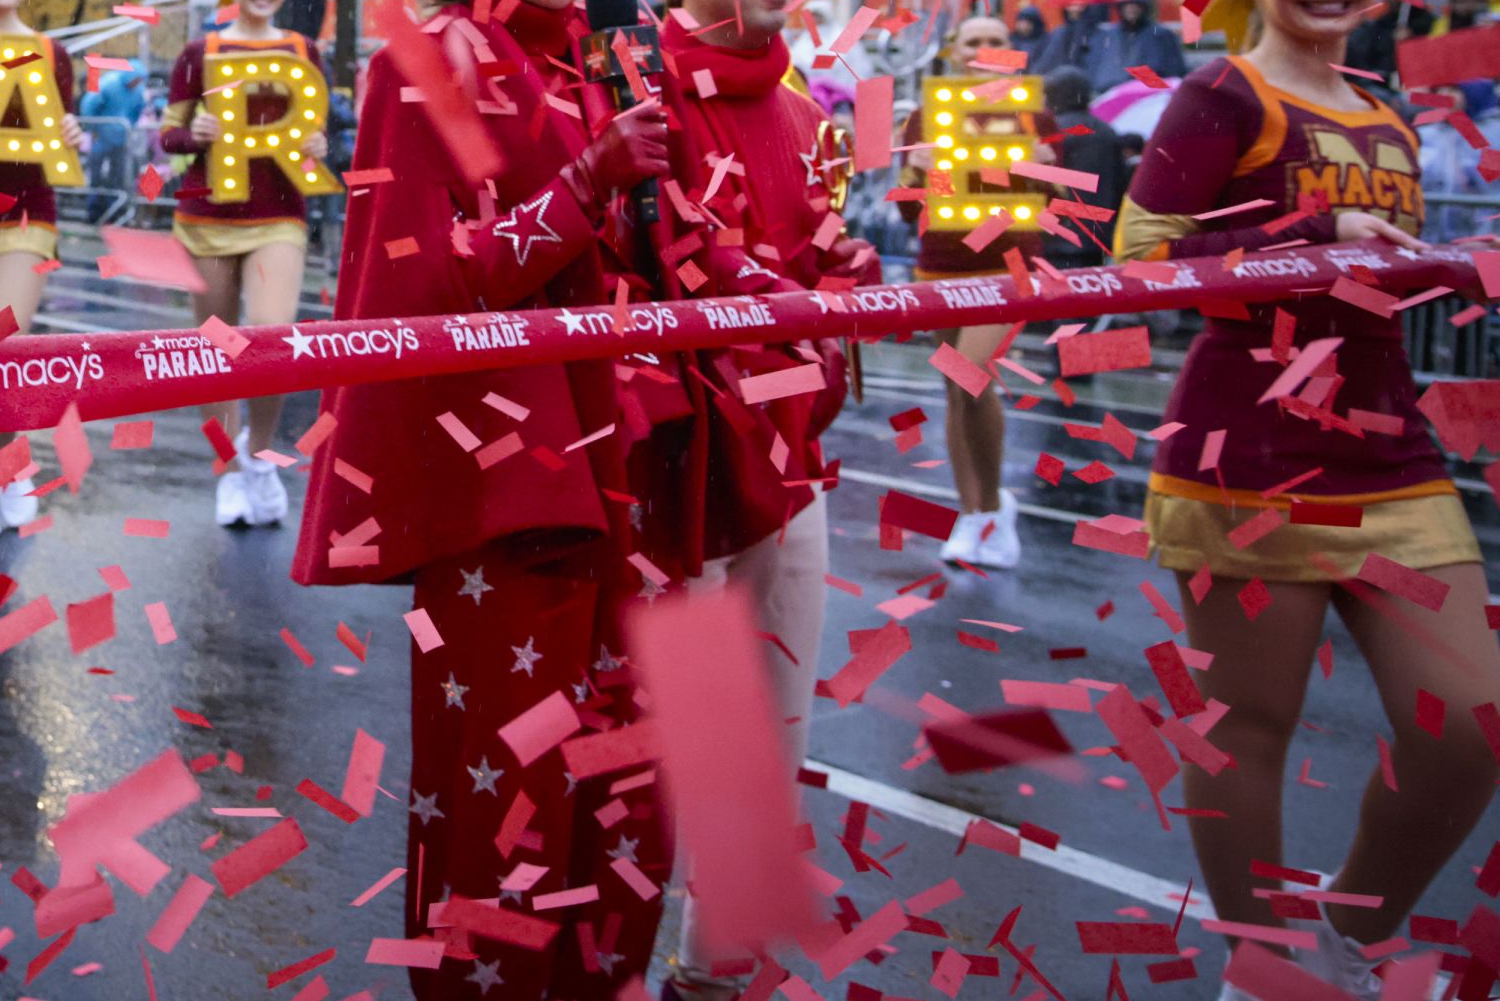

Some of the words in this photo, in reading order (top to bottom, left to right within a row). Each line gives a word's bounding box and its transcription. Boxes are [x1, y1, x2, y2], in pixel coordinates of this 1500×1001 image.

[205, 50, 345, 203] R
[922, 75, 1047, 232] E
[941, 285, 1007, 309] PARADE
[1066, 267, 1122, 297] acy's
[584, 303, 679, 337] mcy's
[164, 335, 212, 351] macys
[316, 319, 420, 359] macy's
[142, 347, 232, 380] PARADE
